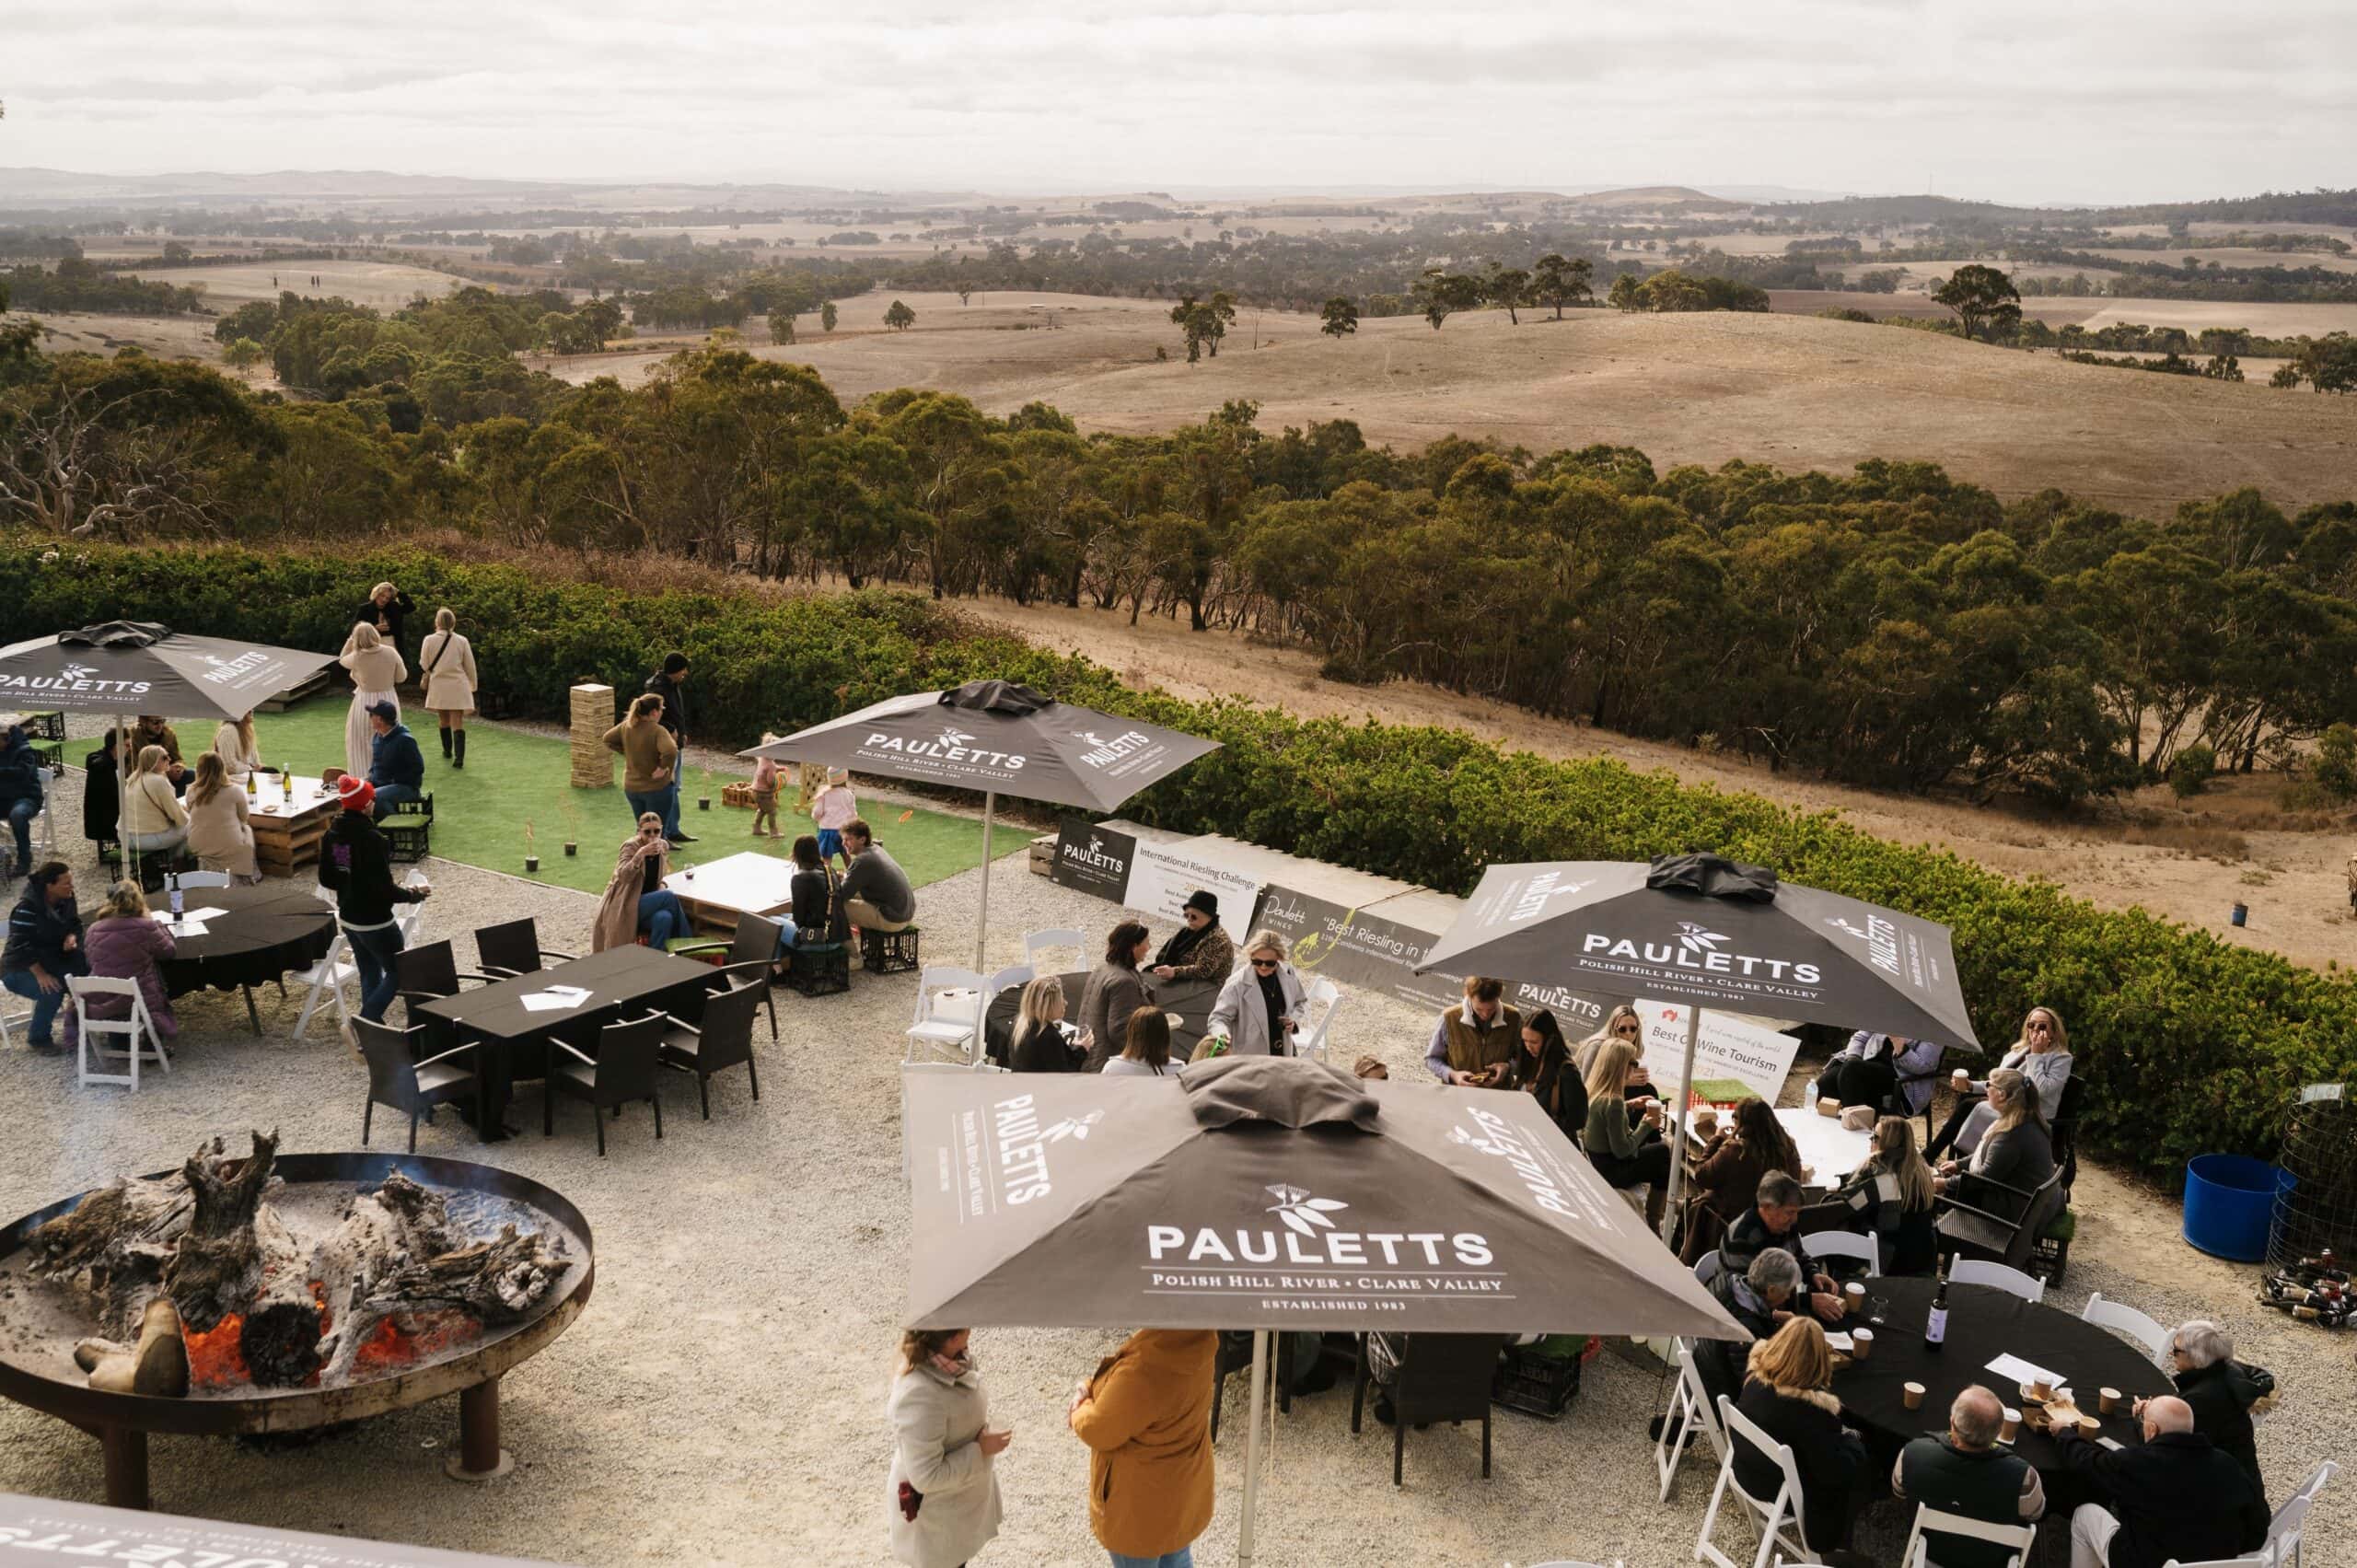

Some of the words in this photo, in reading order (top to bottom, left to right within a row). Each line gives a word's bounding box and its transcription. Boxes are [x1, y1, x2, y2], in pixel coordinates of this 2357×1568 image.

[202, 651, 270, 684] PAULETTS
[856, 749, 888, 761] POLISH
[889, 754, 910, 763] HILL
[912, 758, 940, 768] RIVER
[946, 763, 978, 773] CLARE
[980, 768, 1016, 779] VALLEY
[865, 733, 1027, 770] PAULETTS
[1079, 731, 1150, 769] PAULETTS
[1063, 843, 1123, 874] PAULETTS
[1140, 847, 1190, 868] International
[1190, 861, 1220, 880] Riesling
[1221, 871, 1256, 890] Challenge
[1261, 895, 1306, 923] Paulett
[1268, 918, 1294, 931] WINES
[1355, 927, 1404, 955] Riesling
[1406, 942, 1419, 958] in
[1583, 934, 1821, 984] PAULETTS
[1579, 958, 1626, 972] POLISH
[1629, 965, 1661, 977] HILL
[1664, 970, 1704, 983] RIVER
[1716, 979, 1761, 992] CLARE
[1765, 985, 1819, 999] VALLEY
[1646, 981, 1719, 997] ESTABLISHED
[1723, 993, 1745, 1002] 1983
[1518, 983, 1602, 1018] PAULETTS
[1652, 1026, 1678, 1042] Best
[1697, 1039, 1726, 1056] Wine
[1730, 1048, 1777, 1072] Tourism
[993, 1094, 1052, 1205] PAULETTS
[1466, 1106, 1580, 1220] PAULETTS
[1147, 1225, 1494, 1266] PAULETTS
[1152, 1273, 1221, 1287] POLISH
[1229, 1274, 1275, 1288] HILL
[1282, 1276, 1340, 1290] RIVER
[1358, 1277, 1421, 1291] CLARE
[1425, 1278, 1503, 1292] VALLEY
[1262, 1300, 1368, 1311] ESTABLISHED
[1374, 1301, 1406, 1311] 1983
